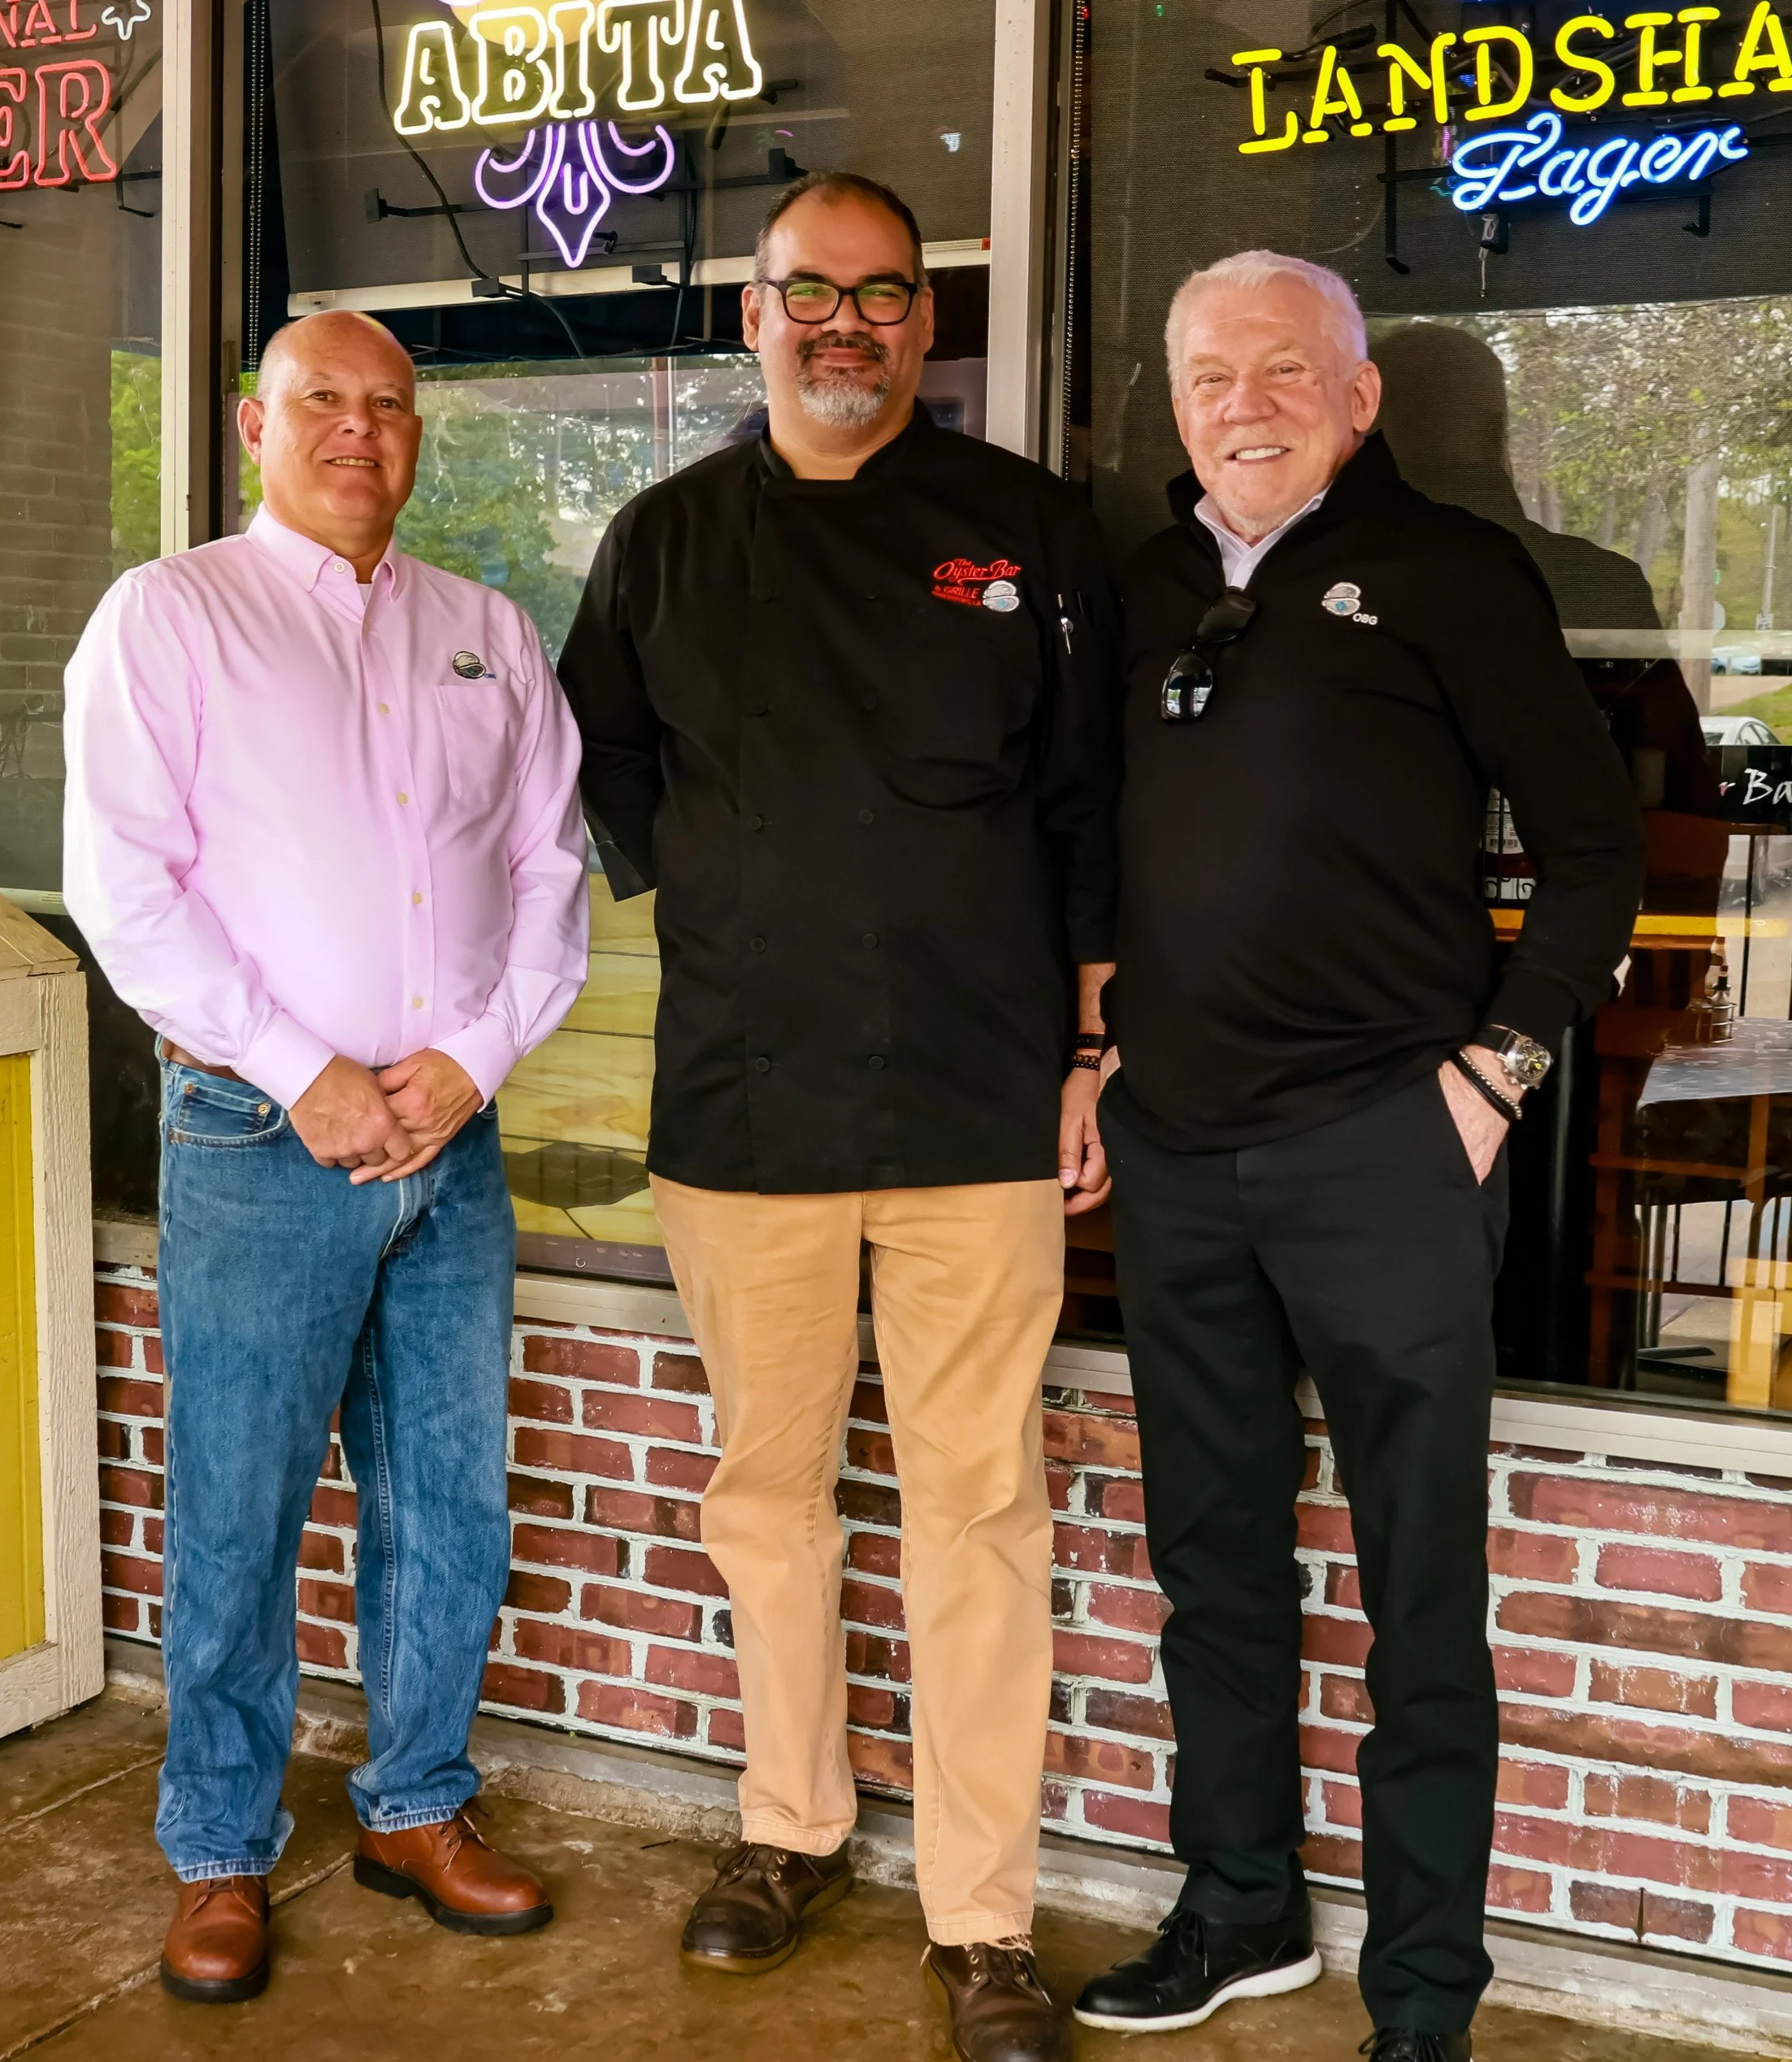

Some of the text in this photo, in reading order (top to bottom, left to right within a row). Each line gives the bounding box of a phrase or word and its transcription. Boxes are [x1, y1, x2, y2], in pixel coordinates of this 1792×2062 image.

[393, 0, 763, 135] ABITA
[1230, 0, 1792, 154] LANDSHA
[1451, 112, 1749, 226] Lager
[933, 561, 988, 583] Oyster
[954, 558, 973, 567] The
[944, 586, 980, 599] GRILLE
[1352, 613, 1378, 625] OBG
[1742, 767, 1792, 805] Ba
